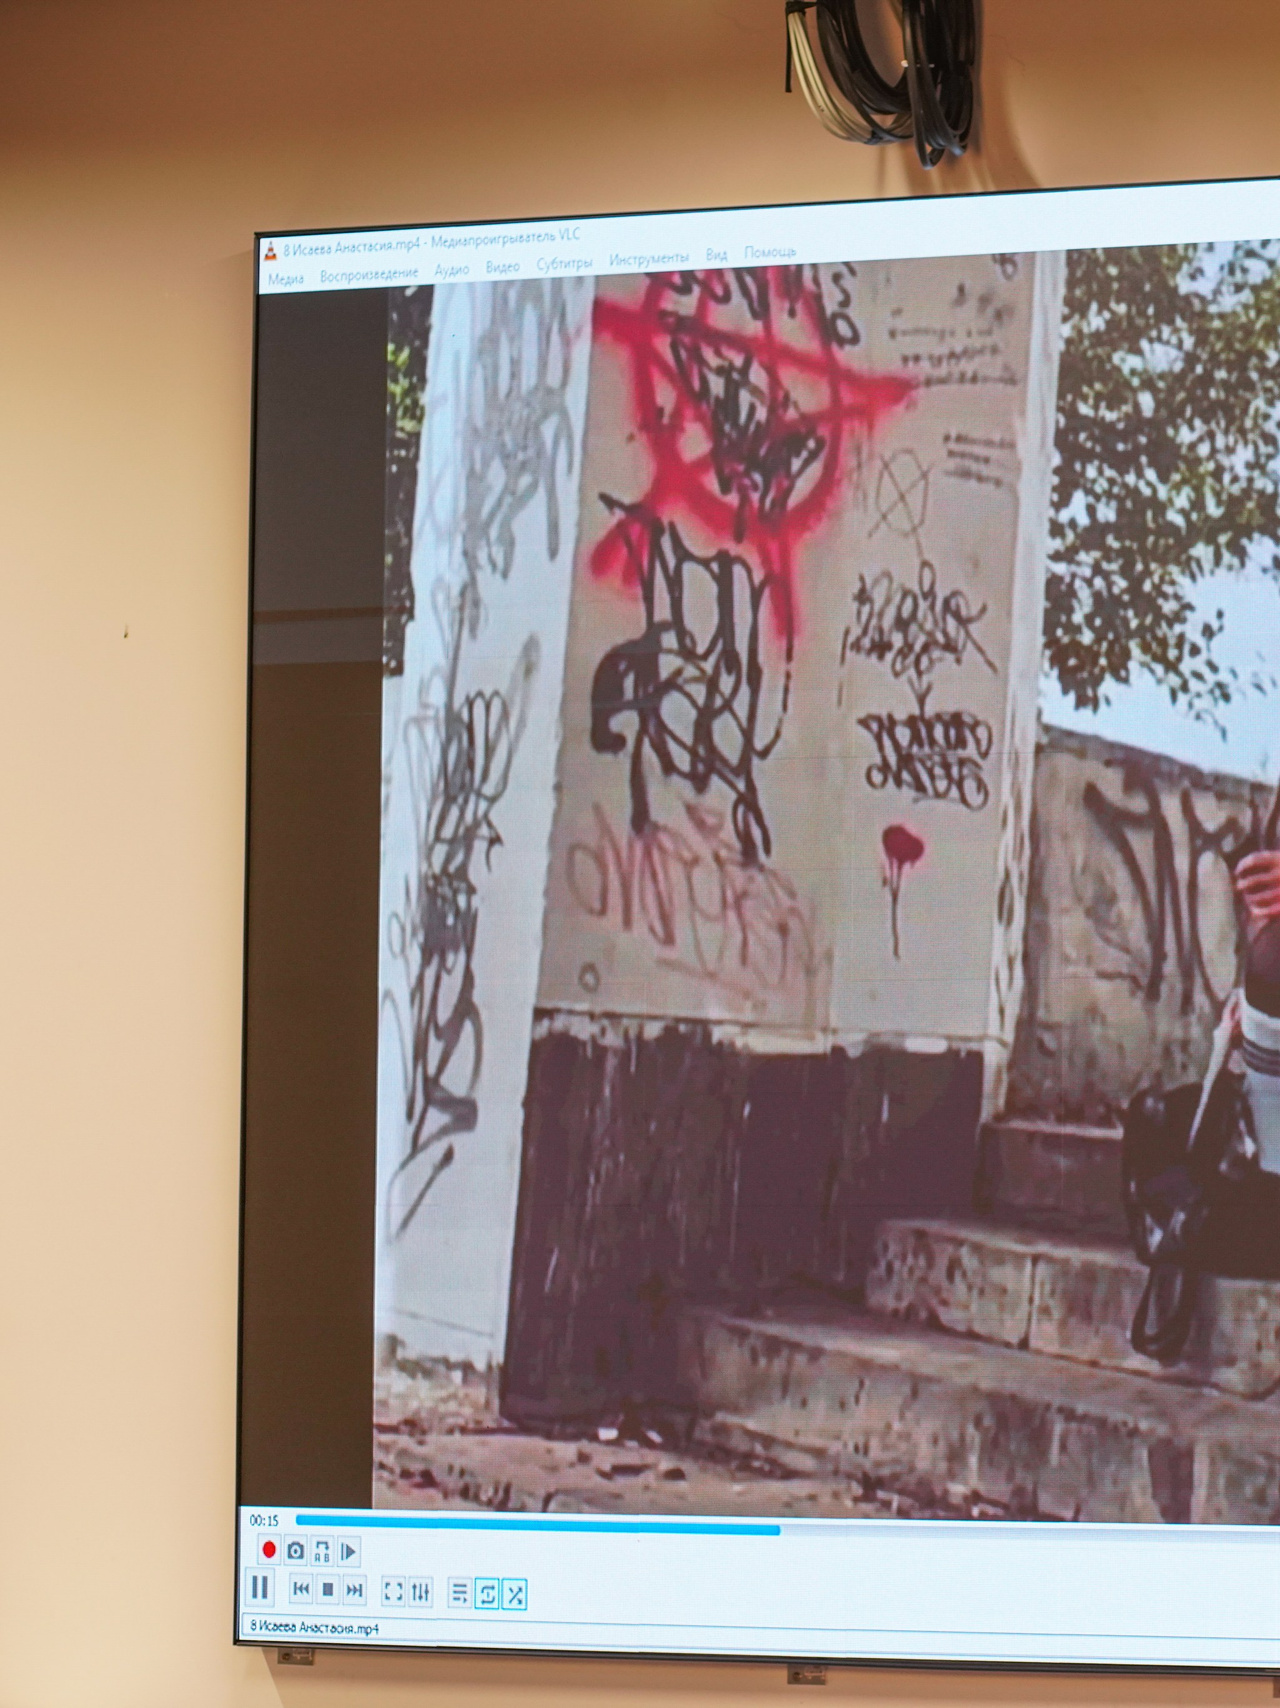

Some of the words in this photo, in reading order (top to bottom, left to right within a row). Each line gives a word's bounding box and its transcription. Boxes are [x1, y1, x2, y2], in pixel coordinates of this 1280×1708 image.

[283, 244, 290, 257] 8
[293, 243, 331, 256] Исаева
[334, 240, 420, 255] Анастасия.mp4
[431, 231, 555, 251] Медиапроигрыватель
[558, 227, 581, 241] VLC
[610, 252, 689, 268] Инструменты
[706, 248, 728, 262] Вид
[745, 246, 797, 260] Помощь
[435, 264, 470, 278] Аудио
[486, 261, 520, 275] Видео
[537, 256, 593, 274] Субтитры
[268, 272, 304, 286] Медиа
[320, 268, 419, 284] Воспроизведение
[250, 1515, 278, 1526] 00:15
[259, 1620, 296, 1633] Исаева
